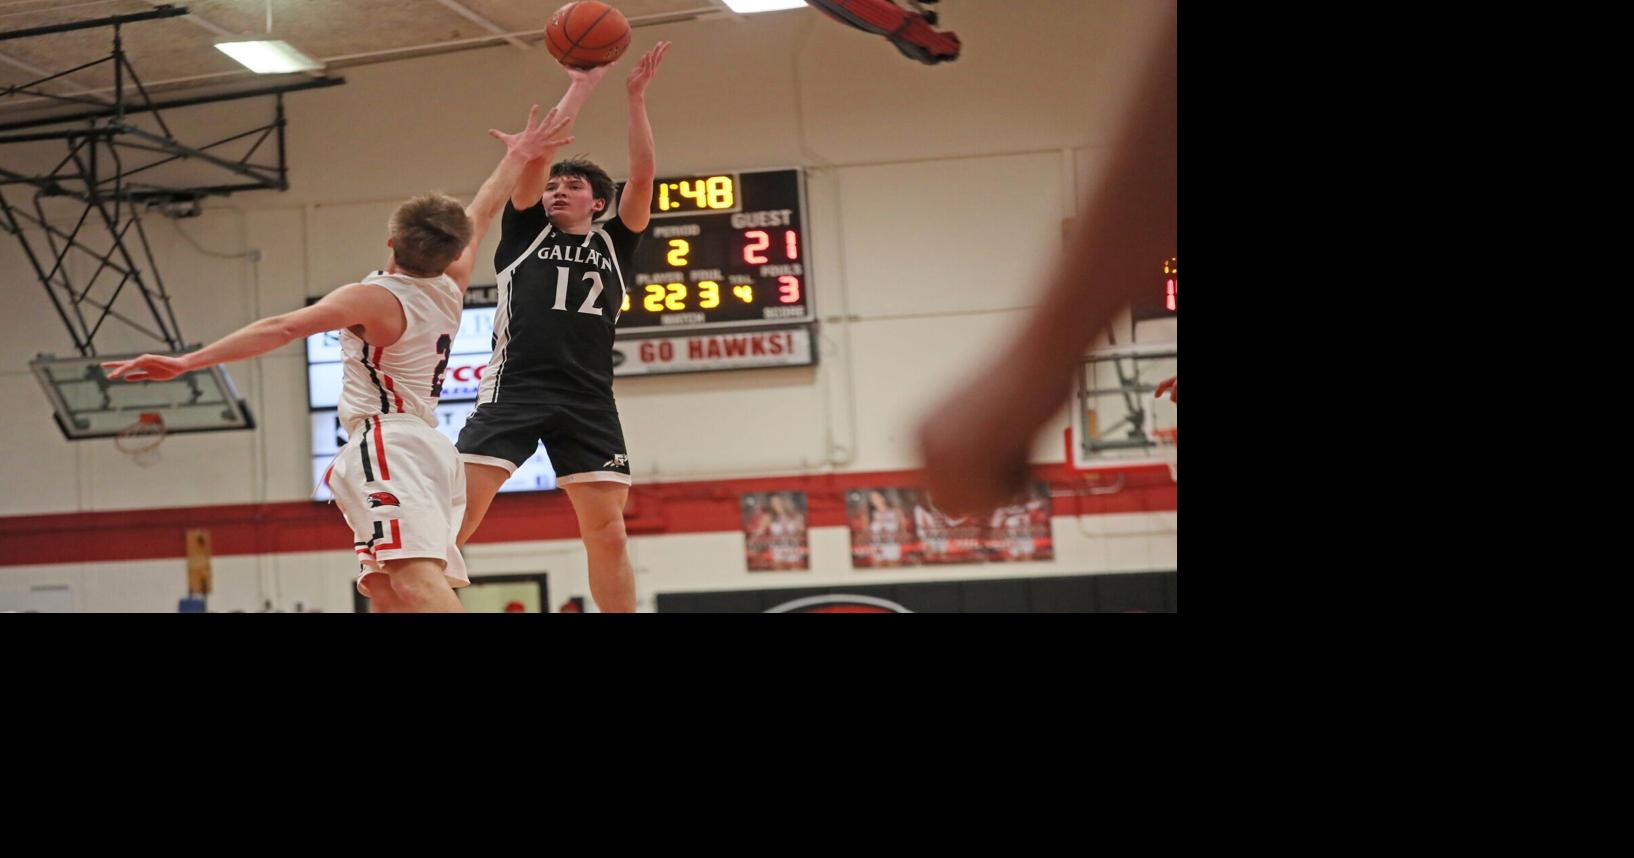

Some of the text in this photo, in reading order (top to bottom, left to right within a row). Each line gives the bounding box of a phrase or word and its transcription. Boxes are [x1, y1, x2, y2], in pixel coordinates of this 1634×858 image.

[659, 176, 734, 211] 1:48
[653, 224, 700, 237] PERIOD
[731, 210, 791, 229] GUEST
[537, 244, 613, 272] GALLATN
[667, 239, 690, 267] 2
[743, 230, 798, 264] 21
[635, 271, 685, 284] PLAYER
[689, 269, 723, 282] FOUL
[760, 263, 802, 276] FOULS
[551, 266, 604, 316] 12
[643, 283, 688, 312] 22
[698, 280, 720, 309] 3
[733, 285, 753, 303] 4
[778, 275, 800, 303] 3
[1166, 278, 1177, 311] 1
[763, 305, 804, 319] SCORE
[639, 332, 795, 363] GO HAWKS!
